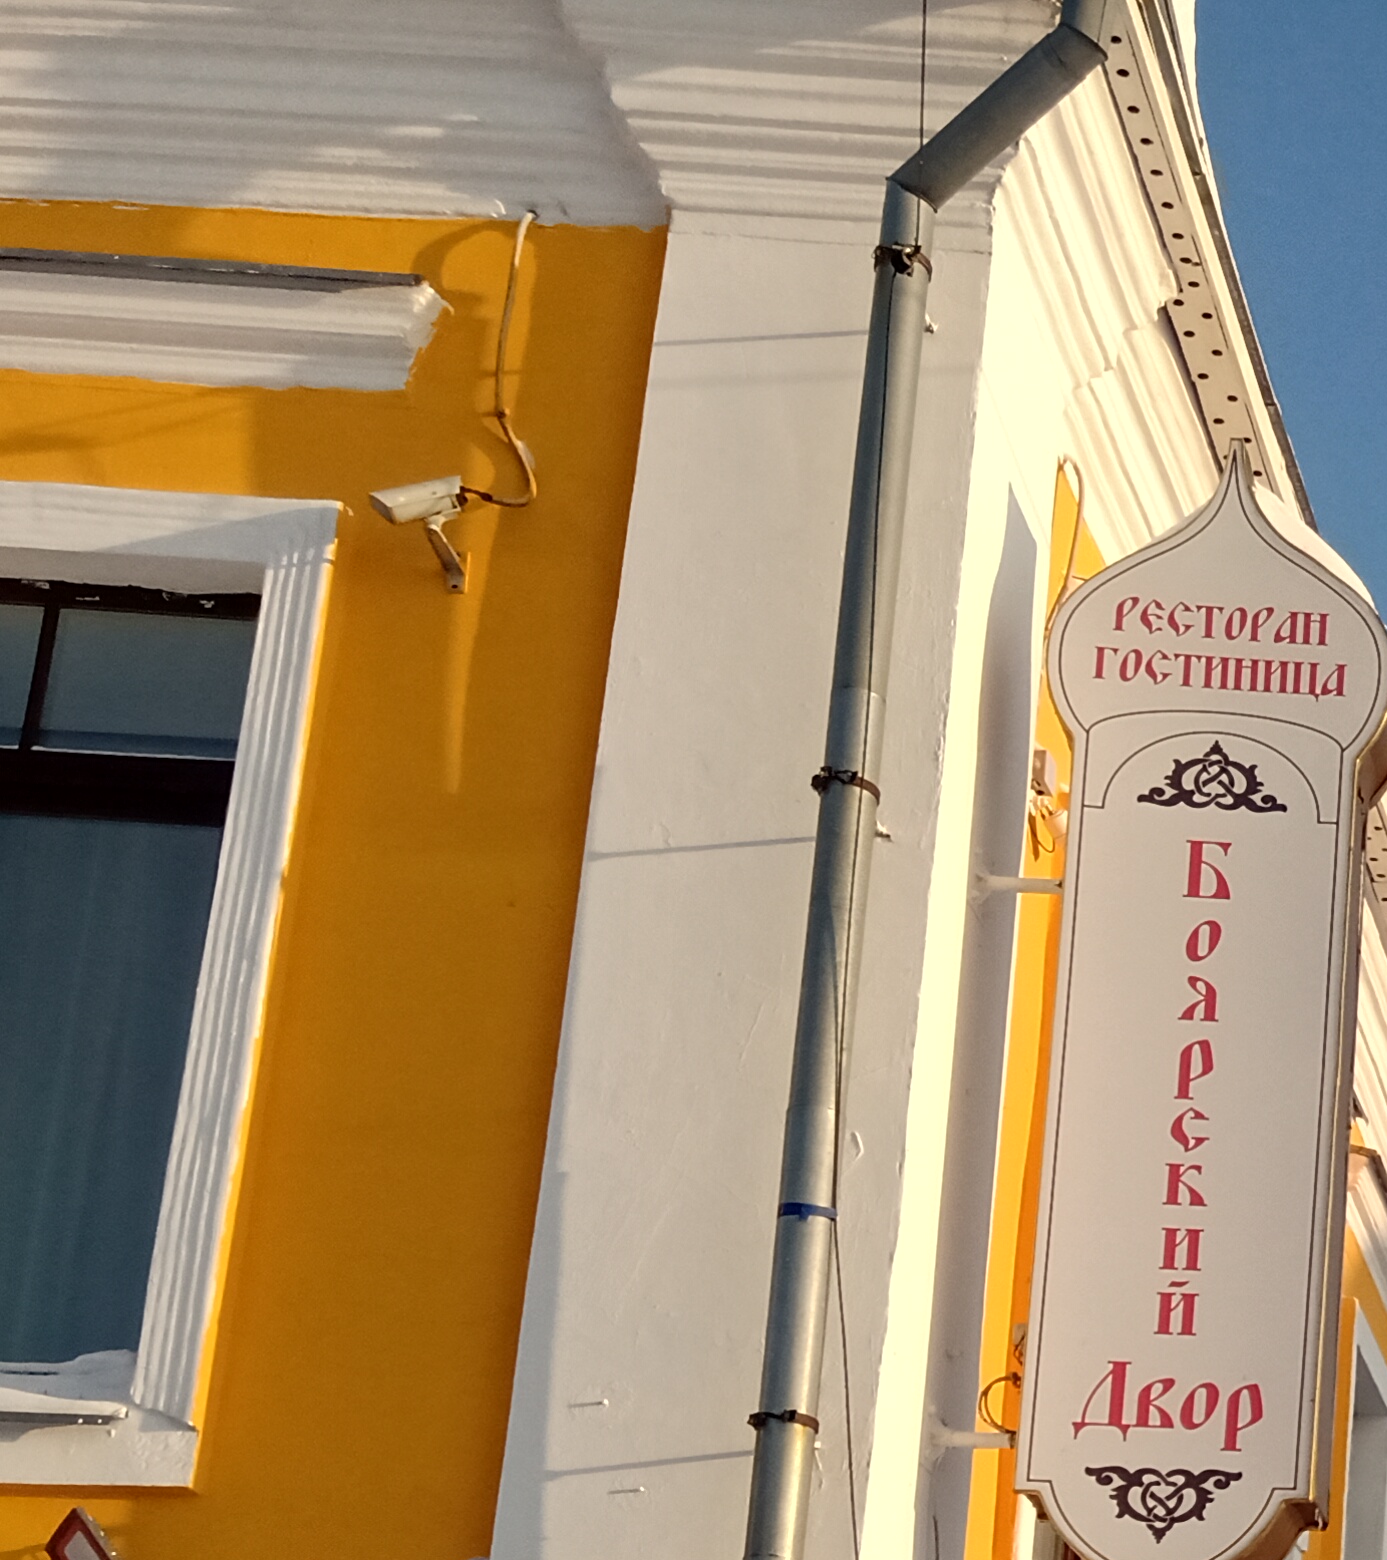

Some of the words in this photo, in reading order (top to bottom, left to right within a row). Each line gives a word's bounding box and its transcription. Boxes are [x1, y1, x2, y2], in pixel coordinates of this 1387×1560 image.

[1112, 596, 1330, 647] РЕСТОРАН
[1092, 646, 1348, 702] ГОСТИНИЦА
[1071, 1360, 1264, 1452] Двор
